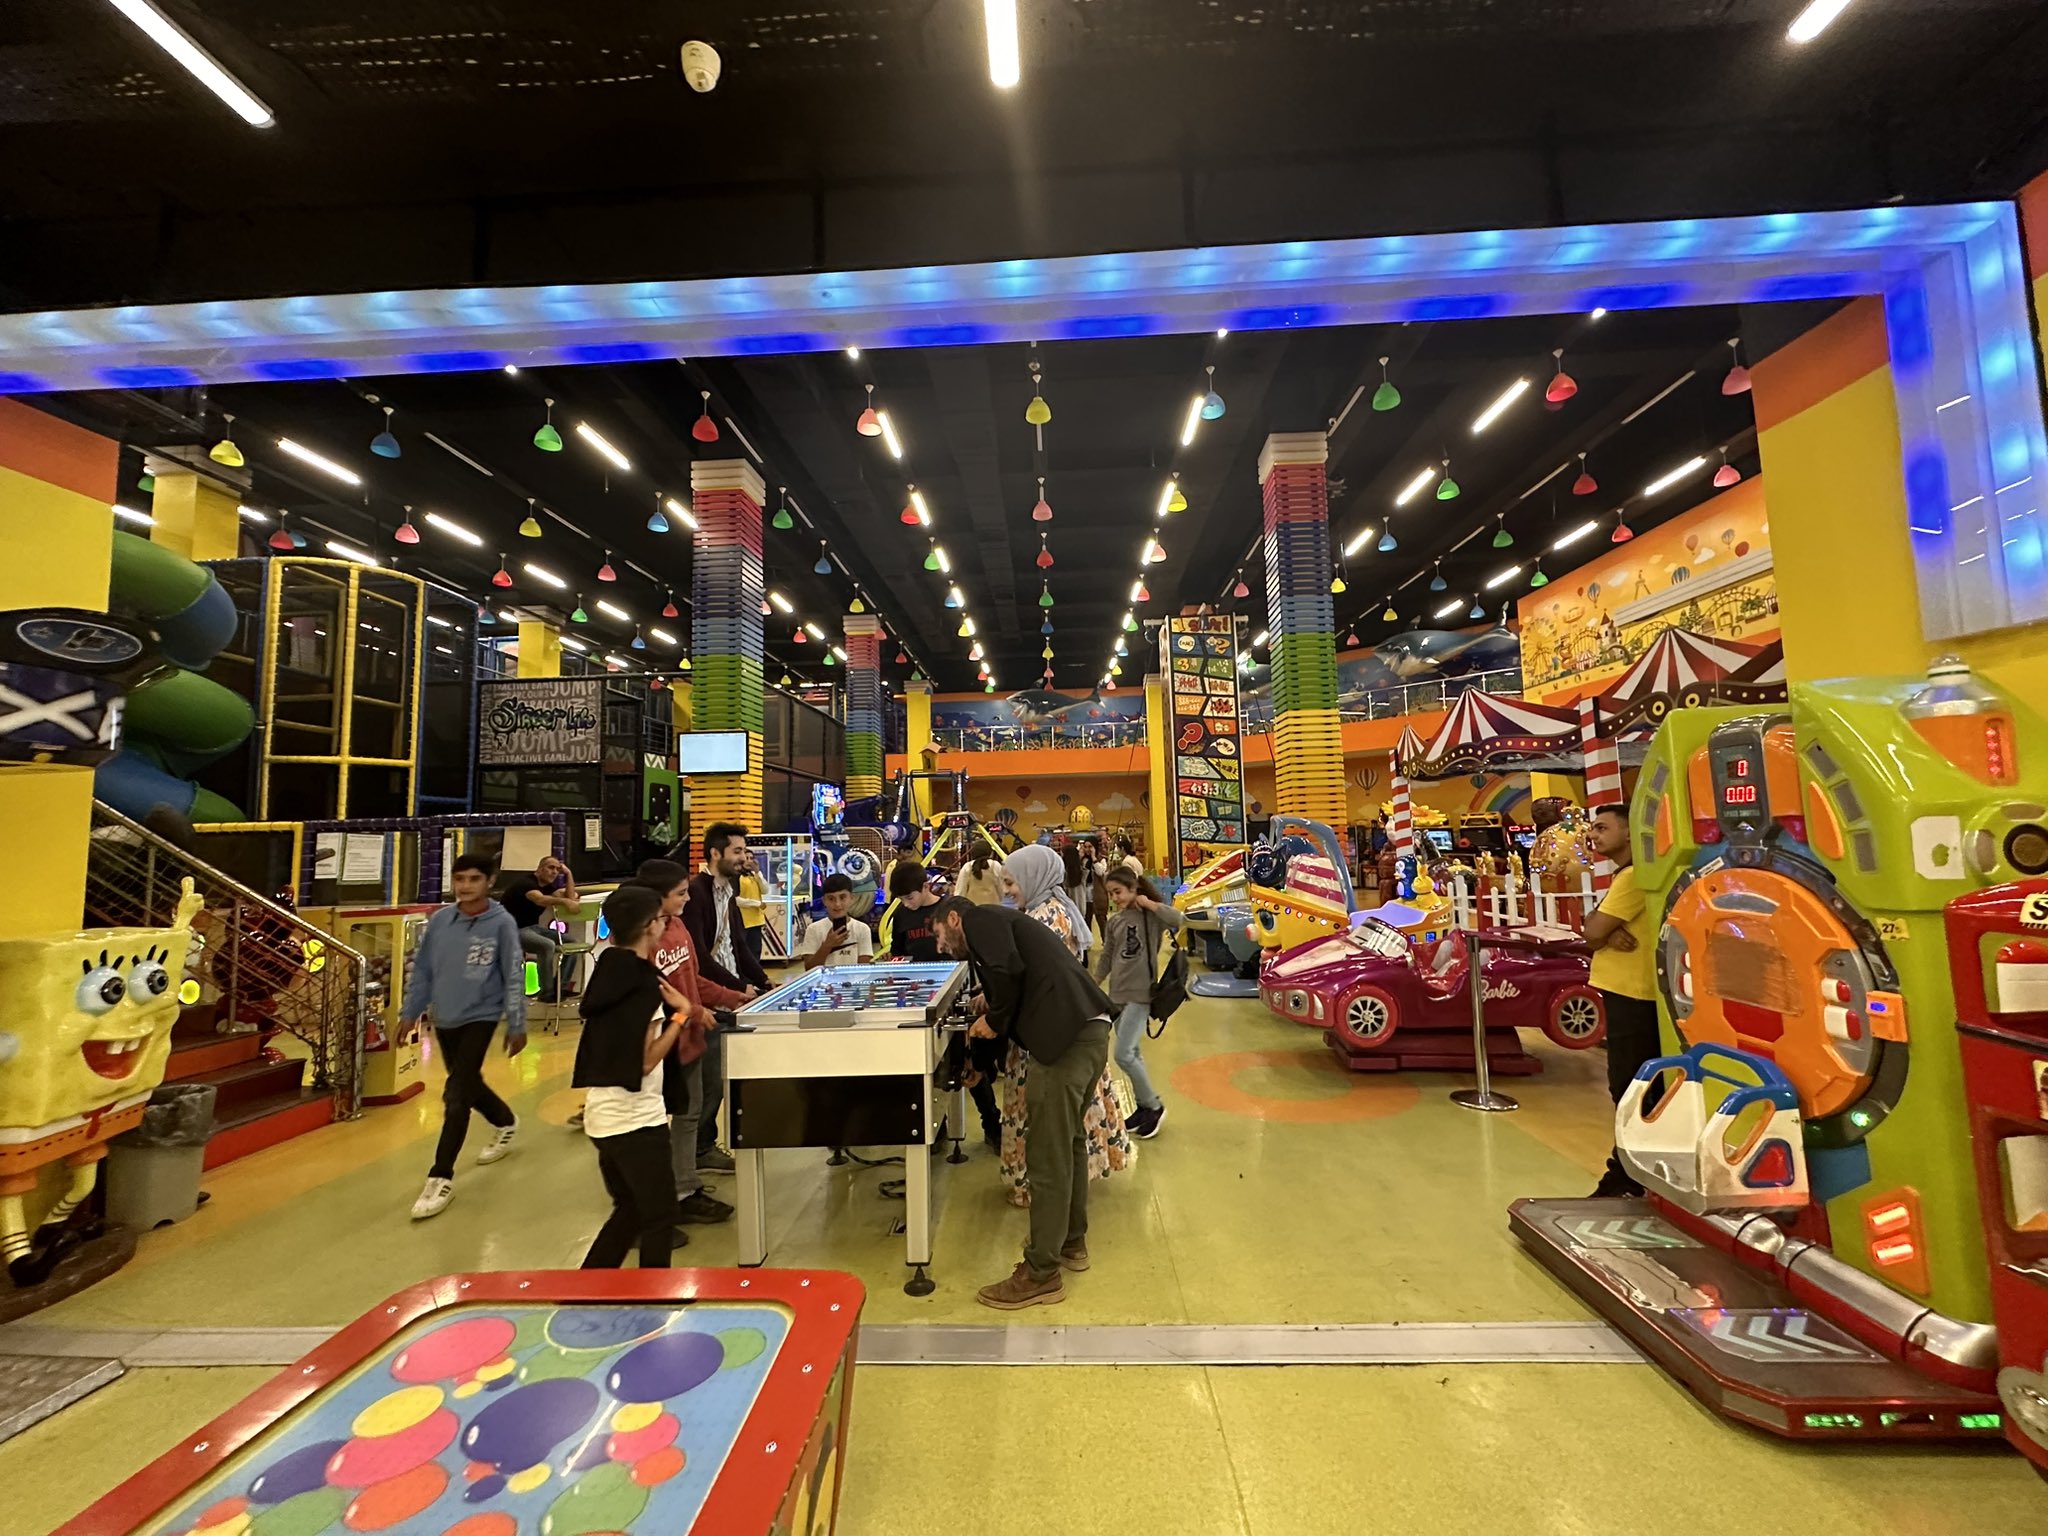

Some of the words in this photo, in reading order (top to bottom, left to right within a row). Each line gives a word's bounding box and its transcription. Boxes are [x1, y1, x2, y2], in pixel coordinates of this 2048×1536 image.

[550, 680, 597, 697] JUMP
[506, 730, 571, 753] JUMP
[1737, 760, 1749, 776] 0
[1481, 979, 1521, 1003] Barbie
